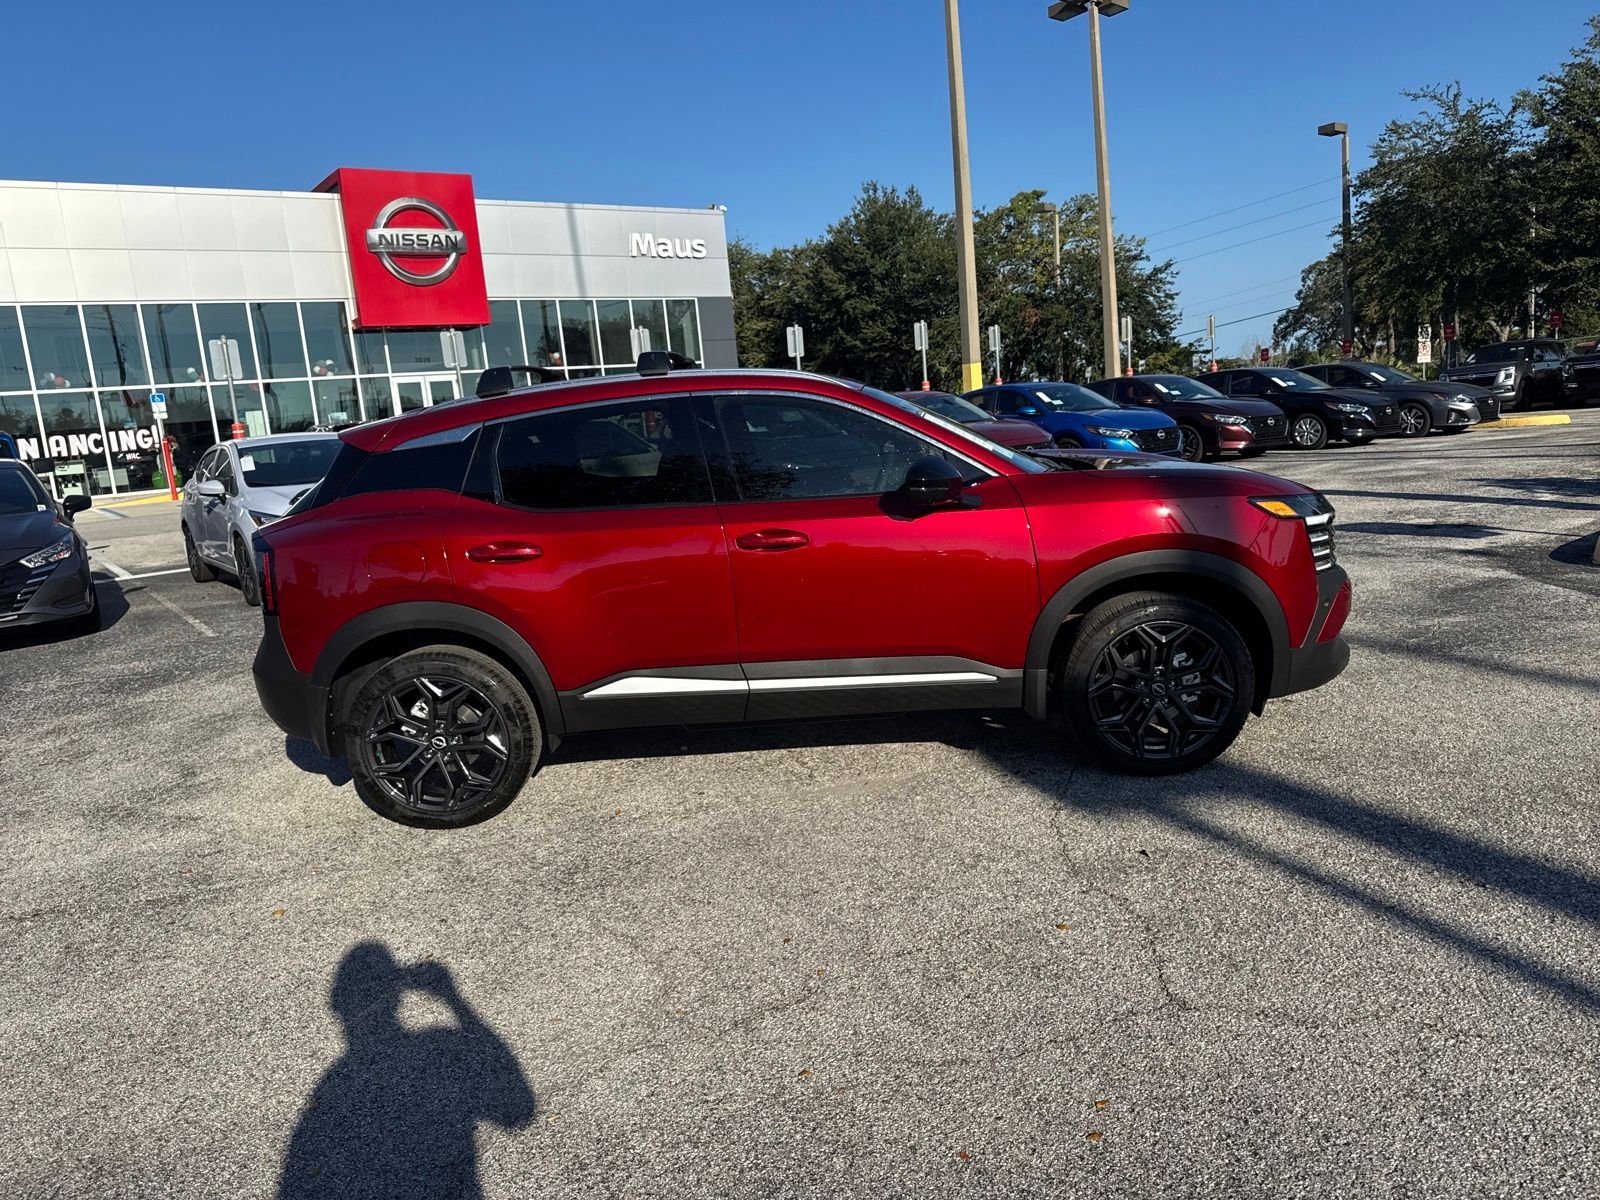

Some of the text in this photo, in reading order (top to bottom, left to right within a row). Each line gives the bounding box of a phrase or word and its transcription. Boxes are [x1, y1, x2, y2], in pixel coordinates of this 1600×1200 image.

[377, 233, 458, 248] NISSAN
[629, 232, 707, 260] Maus
[16, 425, 160, 461] NANCING!
